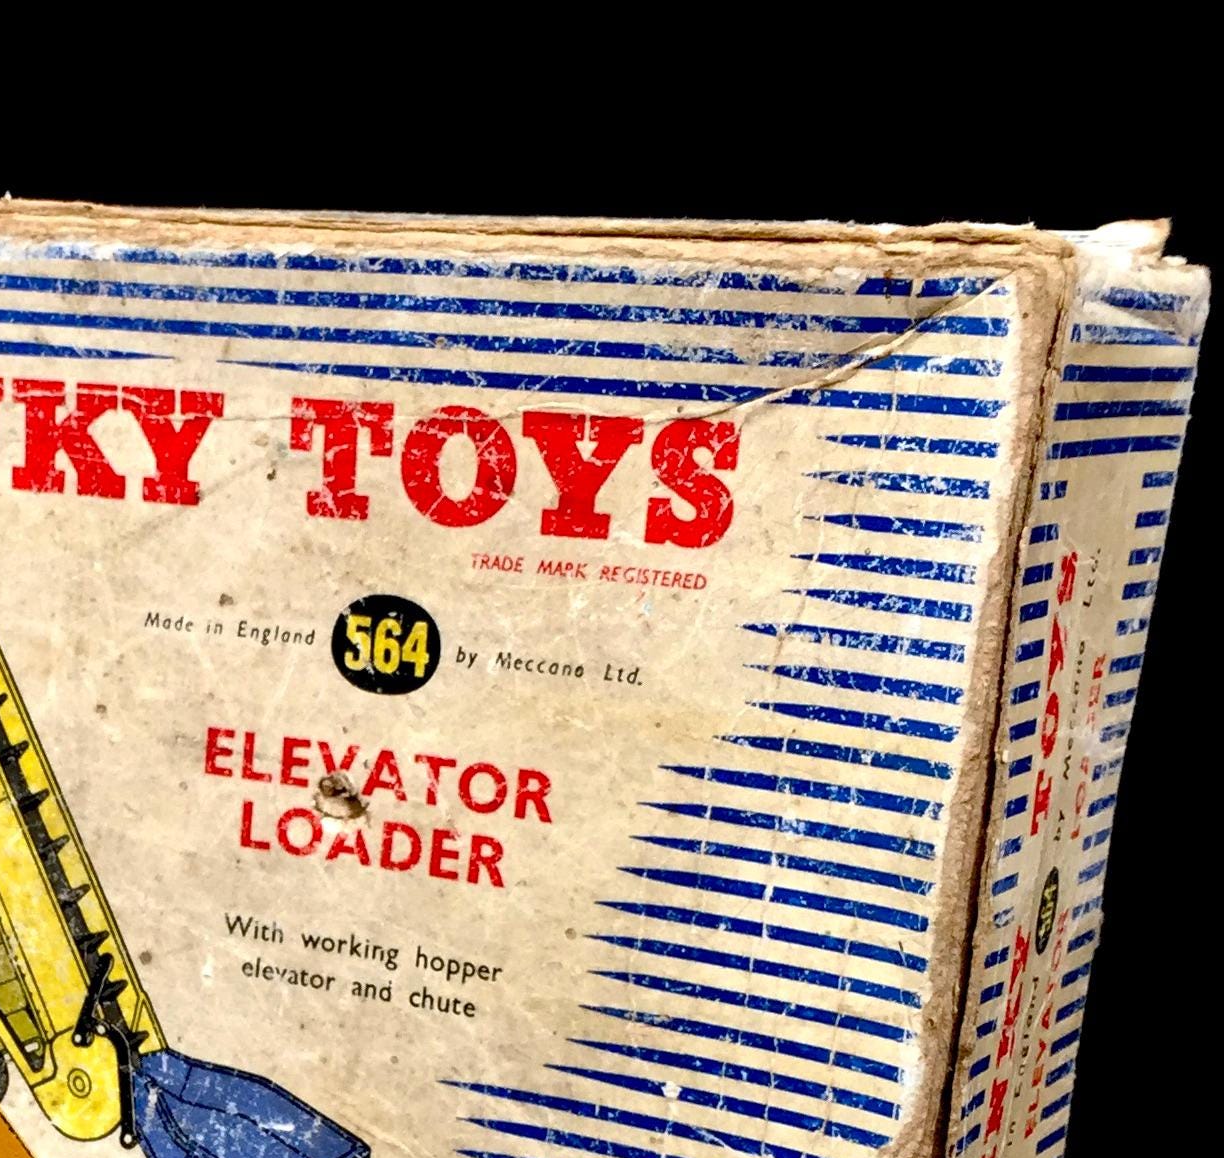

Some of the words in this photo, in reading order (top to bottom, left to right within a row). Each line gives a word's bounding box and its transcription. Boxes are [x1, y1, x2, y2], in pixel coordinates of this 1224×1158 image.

[289, 397, 741, 549] TOYS
[470, 552, 525, 574] TRADE
[536, 558, 587, 581] MARK
[600, 563, 708, 591] REGISTERED
[144, 610, 195, 634] Made
[206, 616, 224, 636] in
[237, 617, 316, 647] England
[343, 615, 431, 678] 564
[456, 644, 478, 669] by
[496, 650, 585, 680] Meccano
[603, 653, 644, 687] Ltd.
[1030, 551, 1079, 837] TOYS
[204, 726, 554, 824] ELEVATOR
[239, 800, 506, 888] LOADER
[1014, 975, 1039, 1098] England
[1054, 809, 1065, 841] by
[1062, 640, 1086, 780] Meccano
[224, 912, 284, 944] With
[301, 932, 399, 970] working
[416, 946, 503, 984] hopper
[241, 958, 336, 992] elevator
[351, 979, 392, 1002] and
[409, 987, 477, 1018] chute
[1024, 908, 1069, 1138] ELEVATOR
